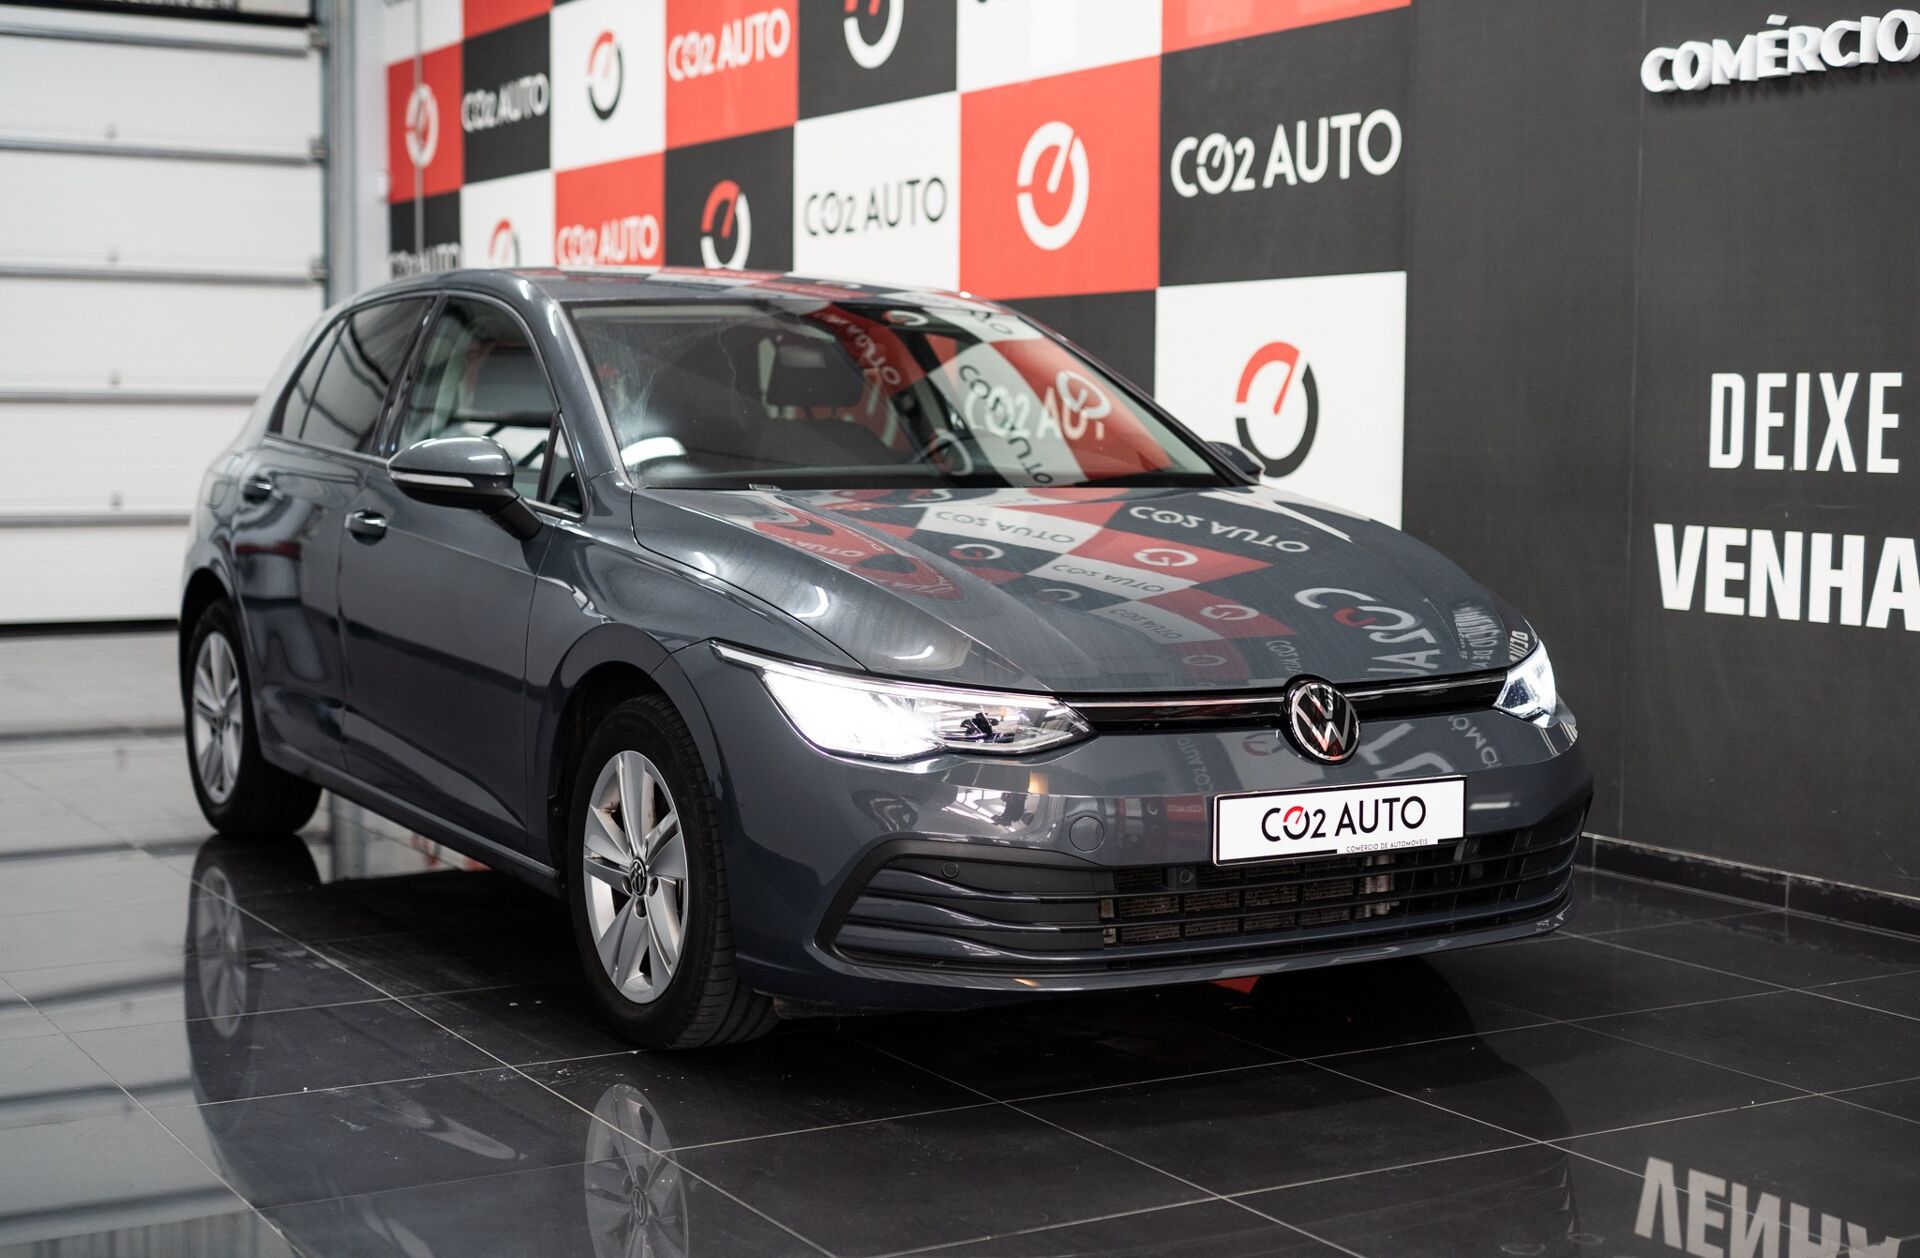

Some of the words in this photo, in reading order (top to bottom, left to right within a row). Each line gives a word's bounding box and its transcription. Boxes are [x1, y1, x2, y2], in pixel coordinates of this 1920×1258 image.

[667, 31, 717, 81] CO2
[716, 8, 790, 71] AUTO
[1641, 9, 1920, 93] COMÉRCIO
[496, 73, 550, 125] AUTO
[1171, 132, 1256, 198] CO2
[1262, 109, 1402, 190] AUTO
[598, 214, 660, 263] AUTO
[804, 191, 857, 236] CO2
[863, 177, 948, 232] AUTO
[1708, 372, 1903, 473] DEIXE
[1653, 523, 1920, 632] VENHA
[1261, 805, 1326, 842] CO2
[1335, 795, 1426, 837] AUTO
[1380, 842, 1388, 850] DE
